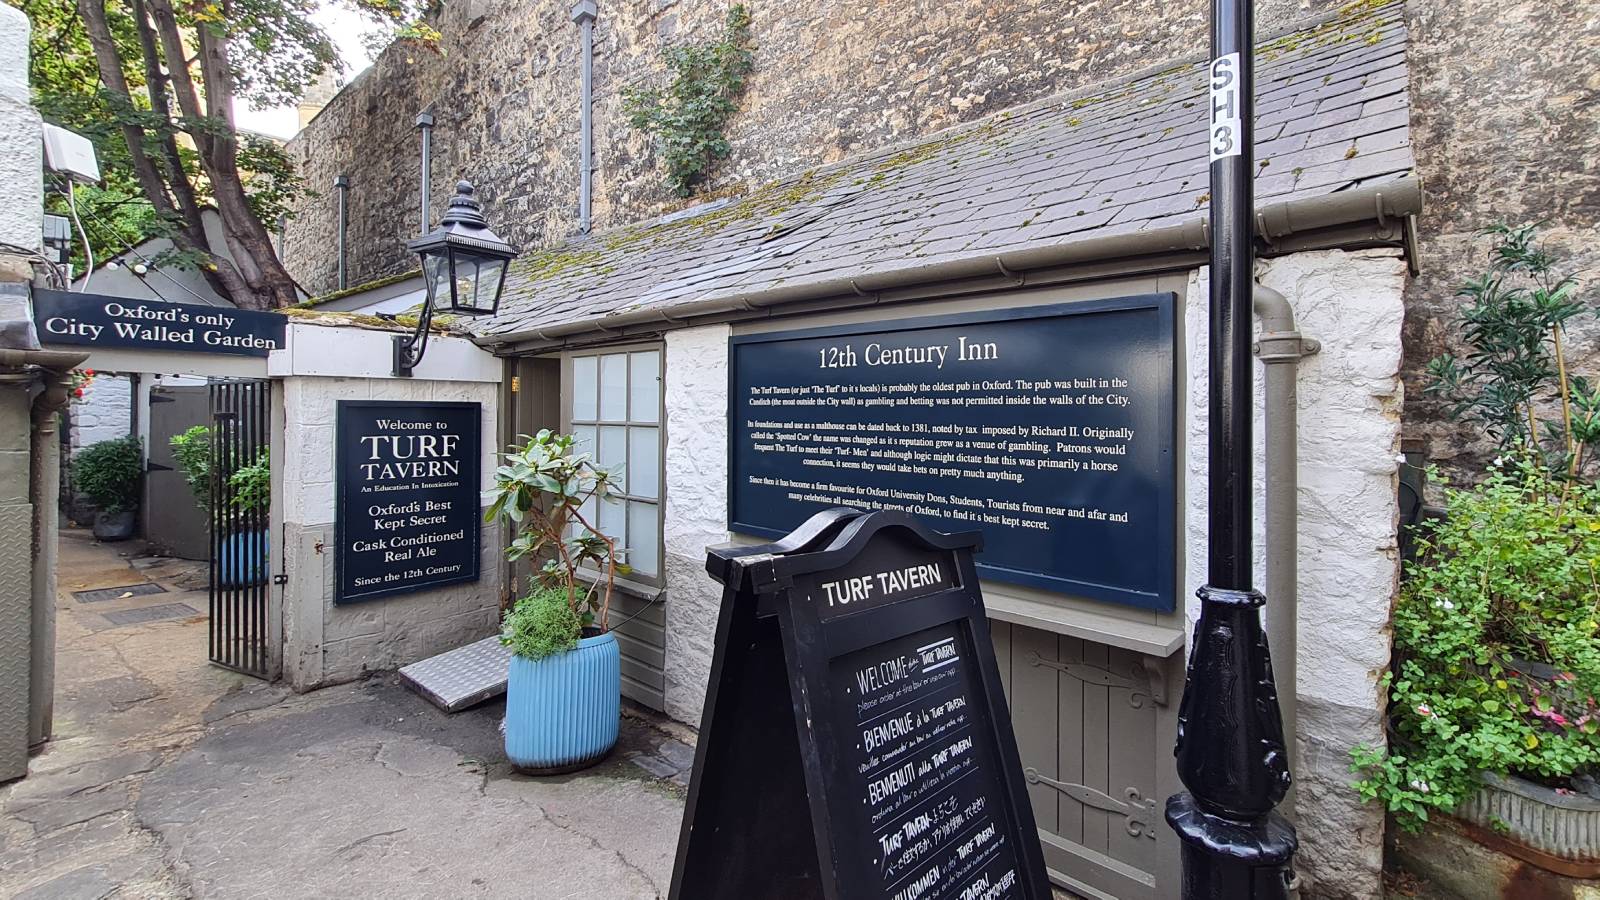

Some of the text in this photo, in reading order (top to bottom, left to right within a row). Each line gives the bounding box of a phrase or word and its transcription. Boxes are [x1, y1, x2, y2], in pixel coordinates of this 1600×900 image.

[104, 303, 235, 329] Oxford's only
[46, 317, 277, 350] City Walled Garden
[819, 335, 999, 370] 12th Century Inn
[858, 376, 1128, 394] locals) is probably the oldest pub in Oxford. The pub was built in the
[825, 393, 1131, 408] City wall) as gambling and betting was not permitted inside the walls of the City.
[376, 419, 432, 430] Welcome
[845, 421, 1135, 441] can dated back 1381, noted by tax imposed by Richard II. Originally
[360, 435, 460, 460] TURF
[839, 434, 1126, 455] was changed as reputation grew as venue of gambling. Patrons would
[360, 460, 459, 480] TAVERN
[841, 460, 1025, 484] seems they would take bets on pretty much anything.
[869, 448, 1119, 472] and although logic might dictate that this was primarily a horse
[374, 484, 409, 492] Education
[368, 501, 452, 516] Oxford's Best
[803, 492, 833, 504] celebrities
[832, 495, 841, 505] all
[841, 498, 871, 510] searching
[871, 500, 883, 512] the
[904, 504, 915, 514] of
[913, 504, 942, 518] Oxford,
[942, 509, 952, 518] to
[952, 508, 968, 520] find
[982, 512, 1001, 524] best
[1001, 514, 1020, 528] kept
[1021, 519, 1050, 530] secret.
[828, 482, 1129, 523] favourite for Oxford University Dons, Students, Tourists from near and afar and
[374, 515, 447, 531] Kept Secret
[353, 529, 464, 552] Cask Conditioned
[384, 546, 437, 562] Real Ale
[355, 564, 461, 586] Since the 12th Century
[822, 562, 941, 607] TURF TAVERN
[856, 655, 909, 695] WELCOME
[863, 711, 914, 753] BIENVENUE
[868, 761, 917, 806] BENVENUTI
[931, 751, 949, 769] TURF
[948, 735, 973, 757] TAVERN
[879, 833, 903, 857] TURF
